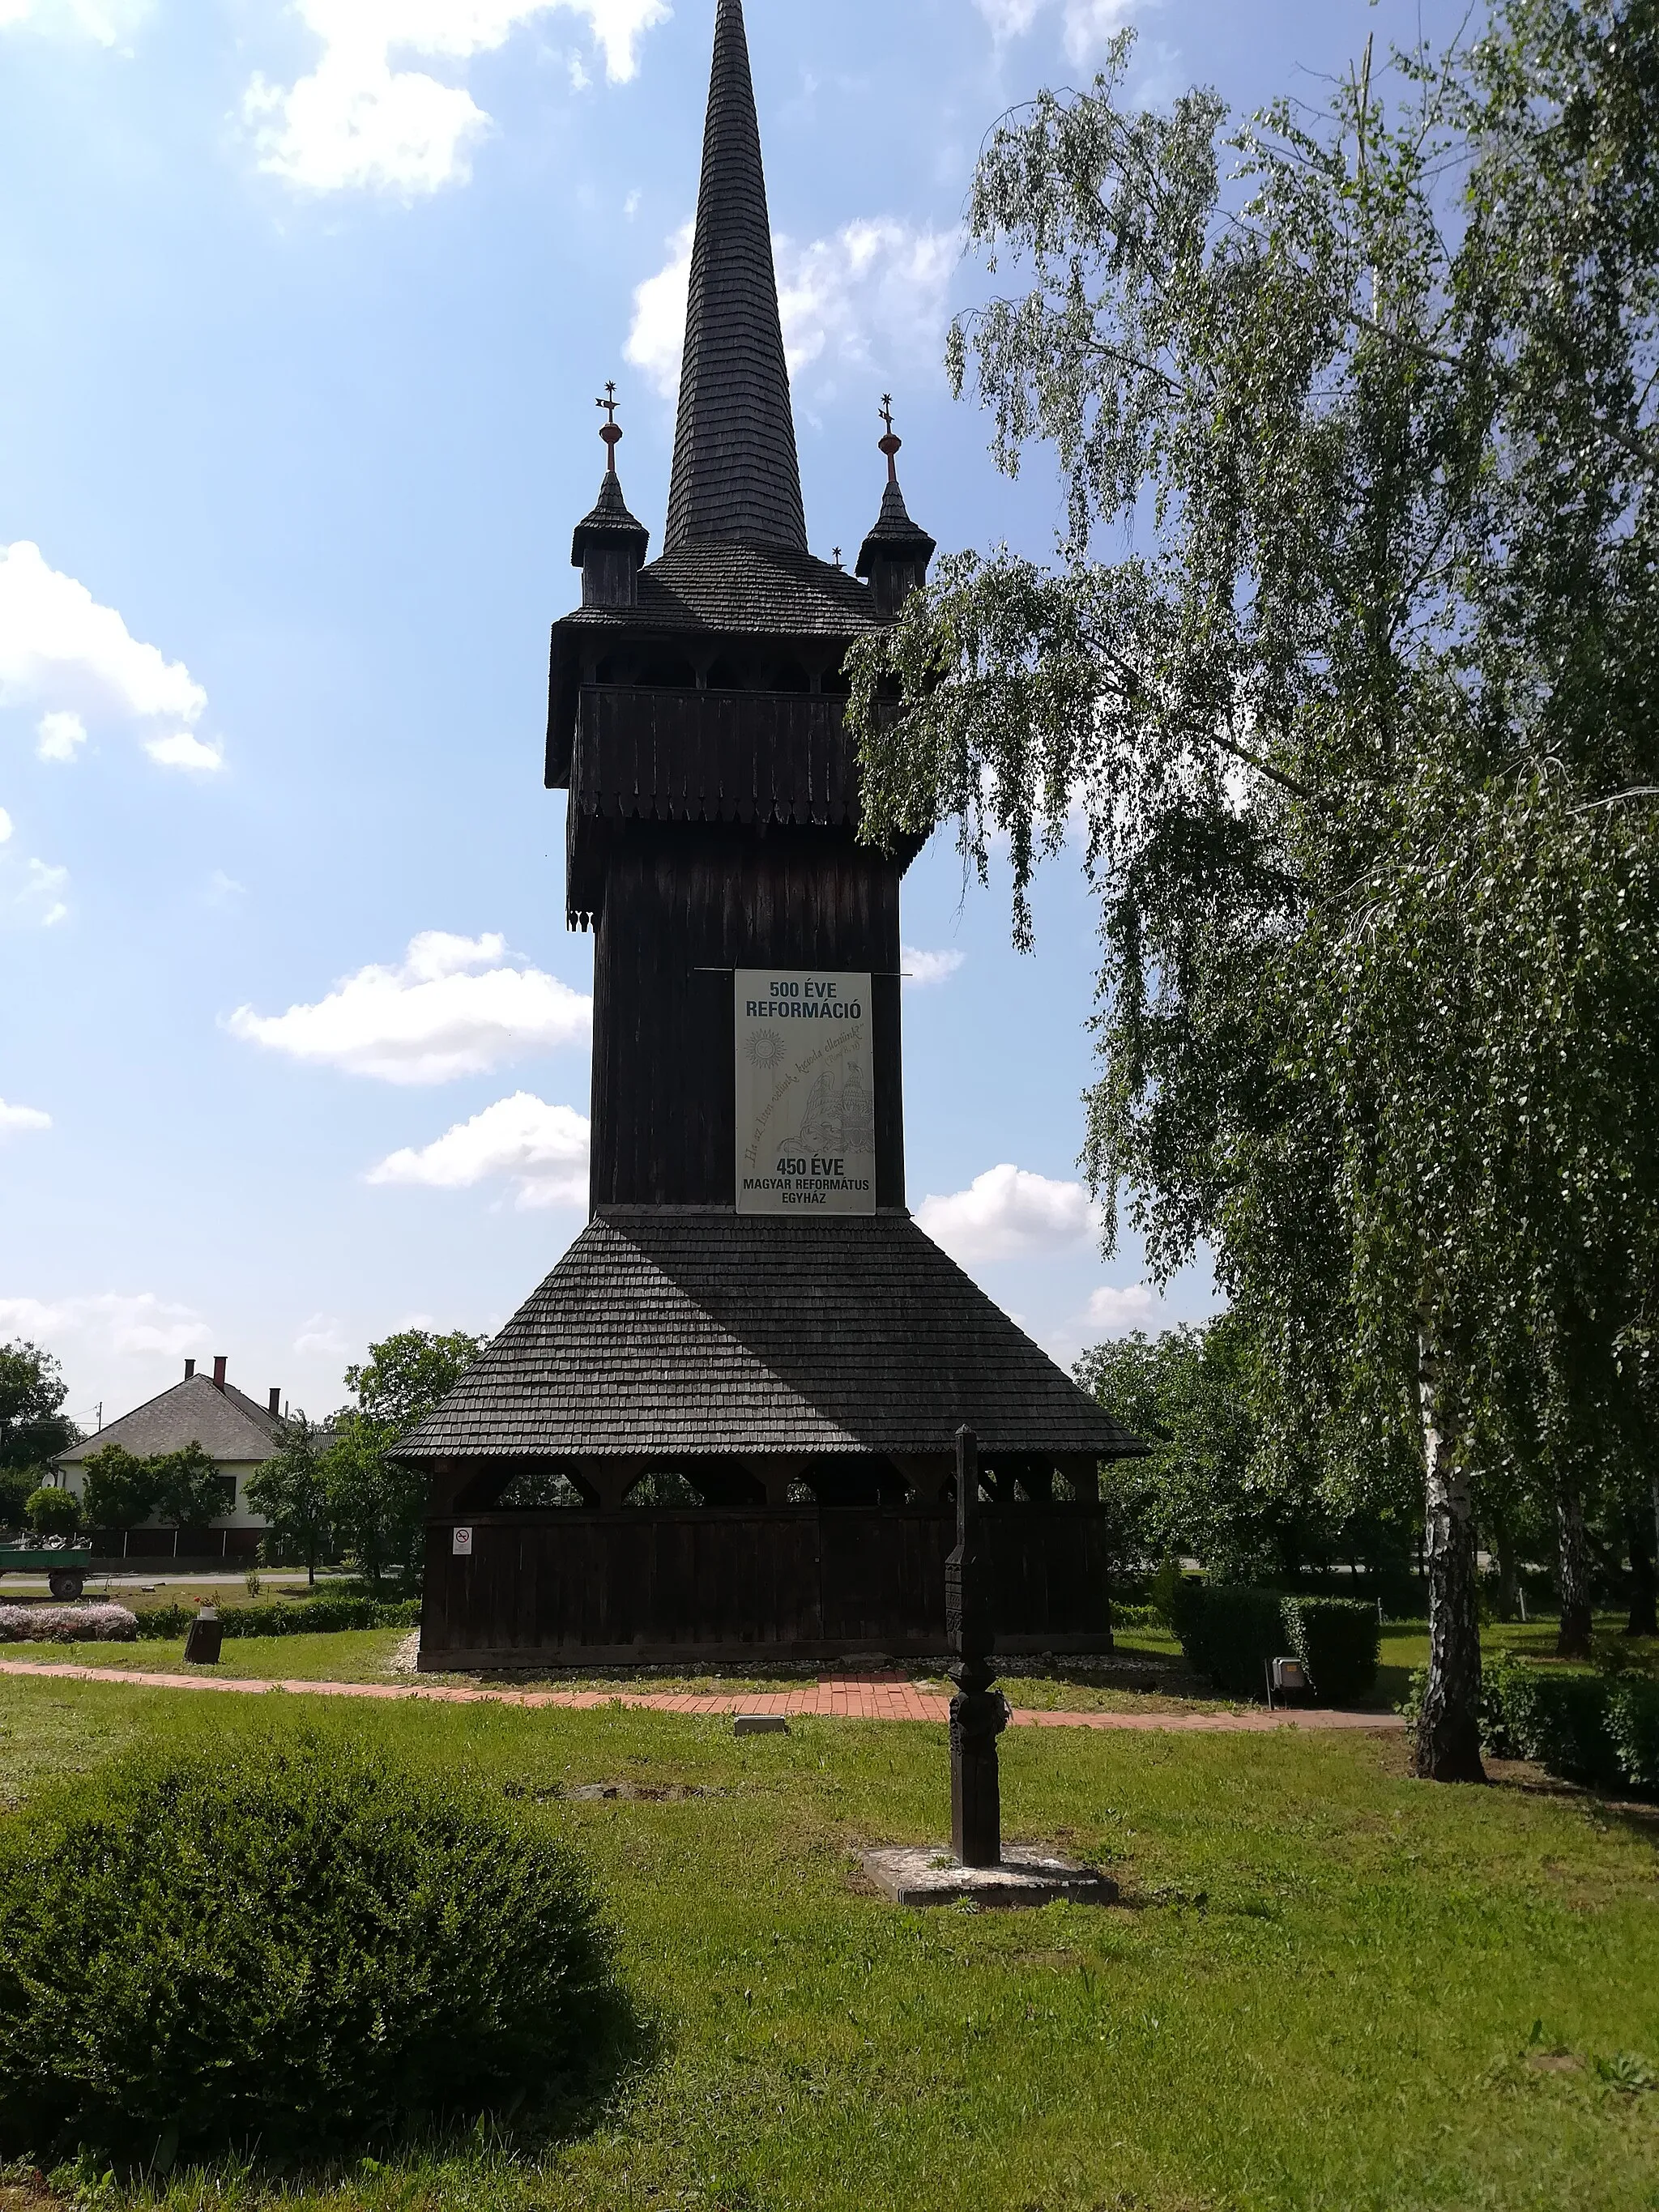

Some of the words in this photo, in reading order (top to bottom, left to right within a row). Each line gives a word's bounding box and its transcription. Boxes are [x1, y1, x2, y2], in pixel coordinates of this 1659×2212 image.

[770, 981, 799, 998] 500
[804, 978, 837, 998] ÉVE
[746, 998, 861, 1019] REFORMÁCIÓ
[776, 1157, 807, 1175] 450
[811, 1153, 844, 1175] ÉVE
[743, 1178, 791, 1190] MAGYAR
[795, 1177, 869, 1191] REFORMÁTUS
[782, 1191, 826, 1204] EGYHÁZ
